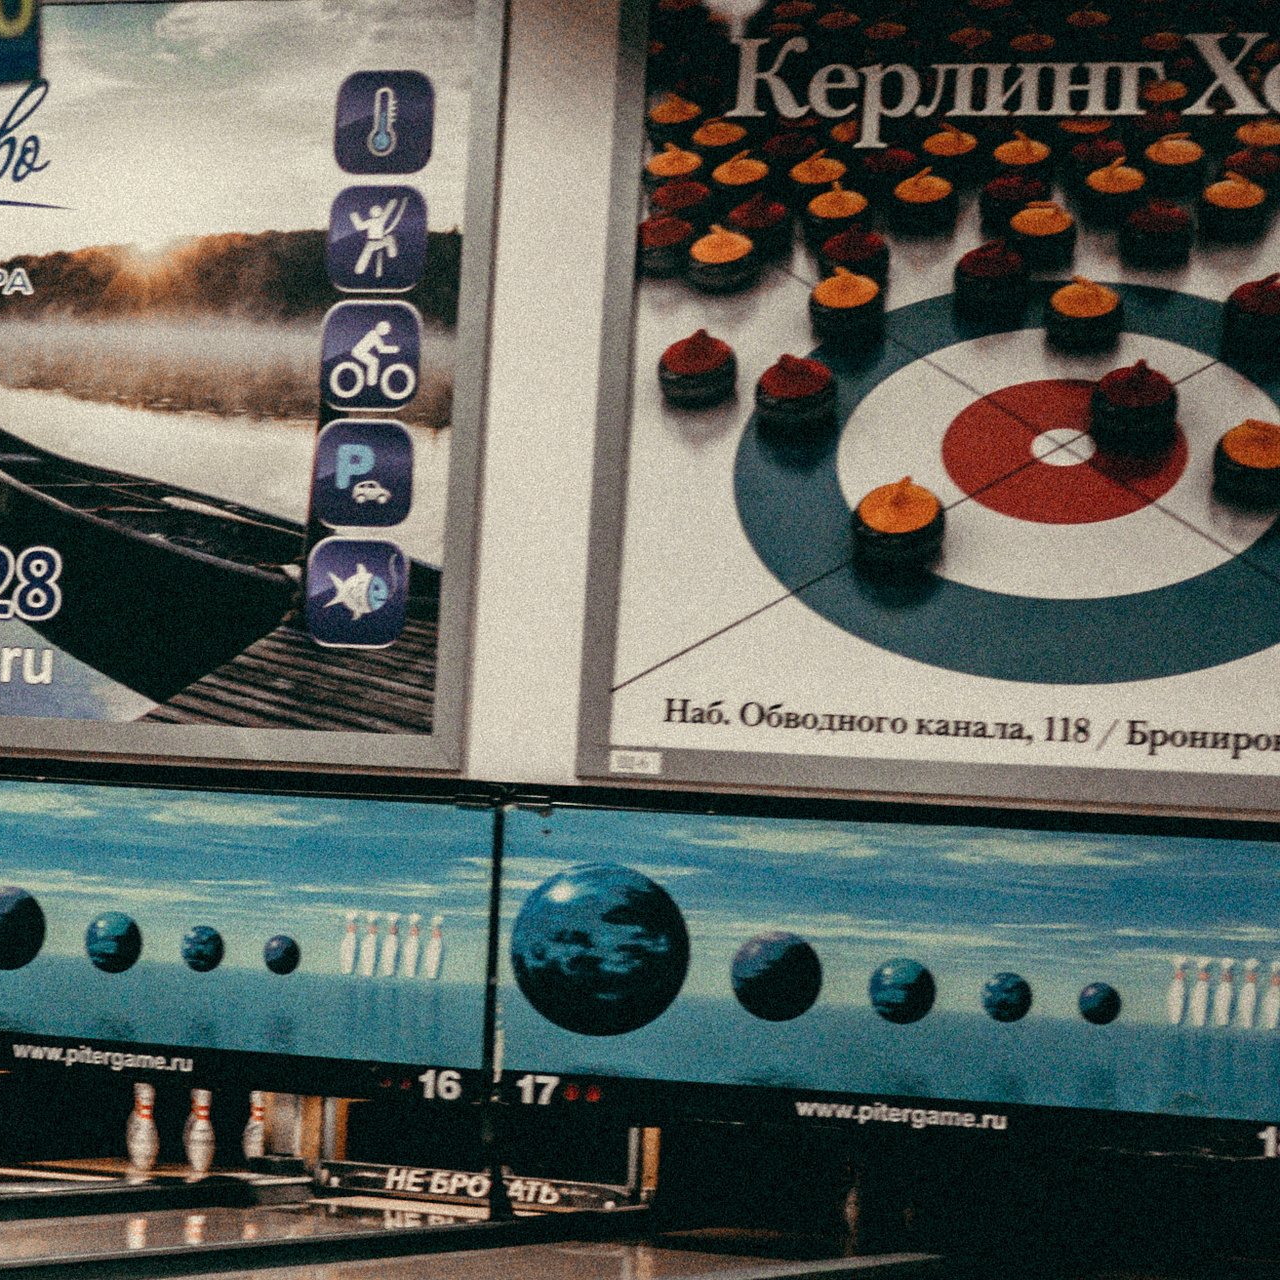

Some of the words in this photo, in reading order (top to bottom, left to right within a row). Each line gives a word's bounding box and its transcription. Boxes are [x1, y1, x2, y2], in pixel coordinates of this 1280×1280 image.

[723, 34, 1166, 149] Керлинг
[663, 697, 730, 726] Наб.
[740, 701, 908, 735] Обводного
[915, 719, 1033, 747] канала,
[1043, 716, 1091, 743] 118
[12, 1043, 194, 1072] www.pitergame.ru
[418, 1069, 462, 1101] 16
[516, 1074, 560, 1105] 17
[794, 1101, 1009, 1131] www.pitergame.ru
[385, 1168, 425, 1192] НЕ
[428, 1171, 560, 1205] БРОАТЬ
